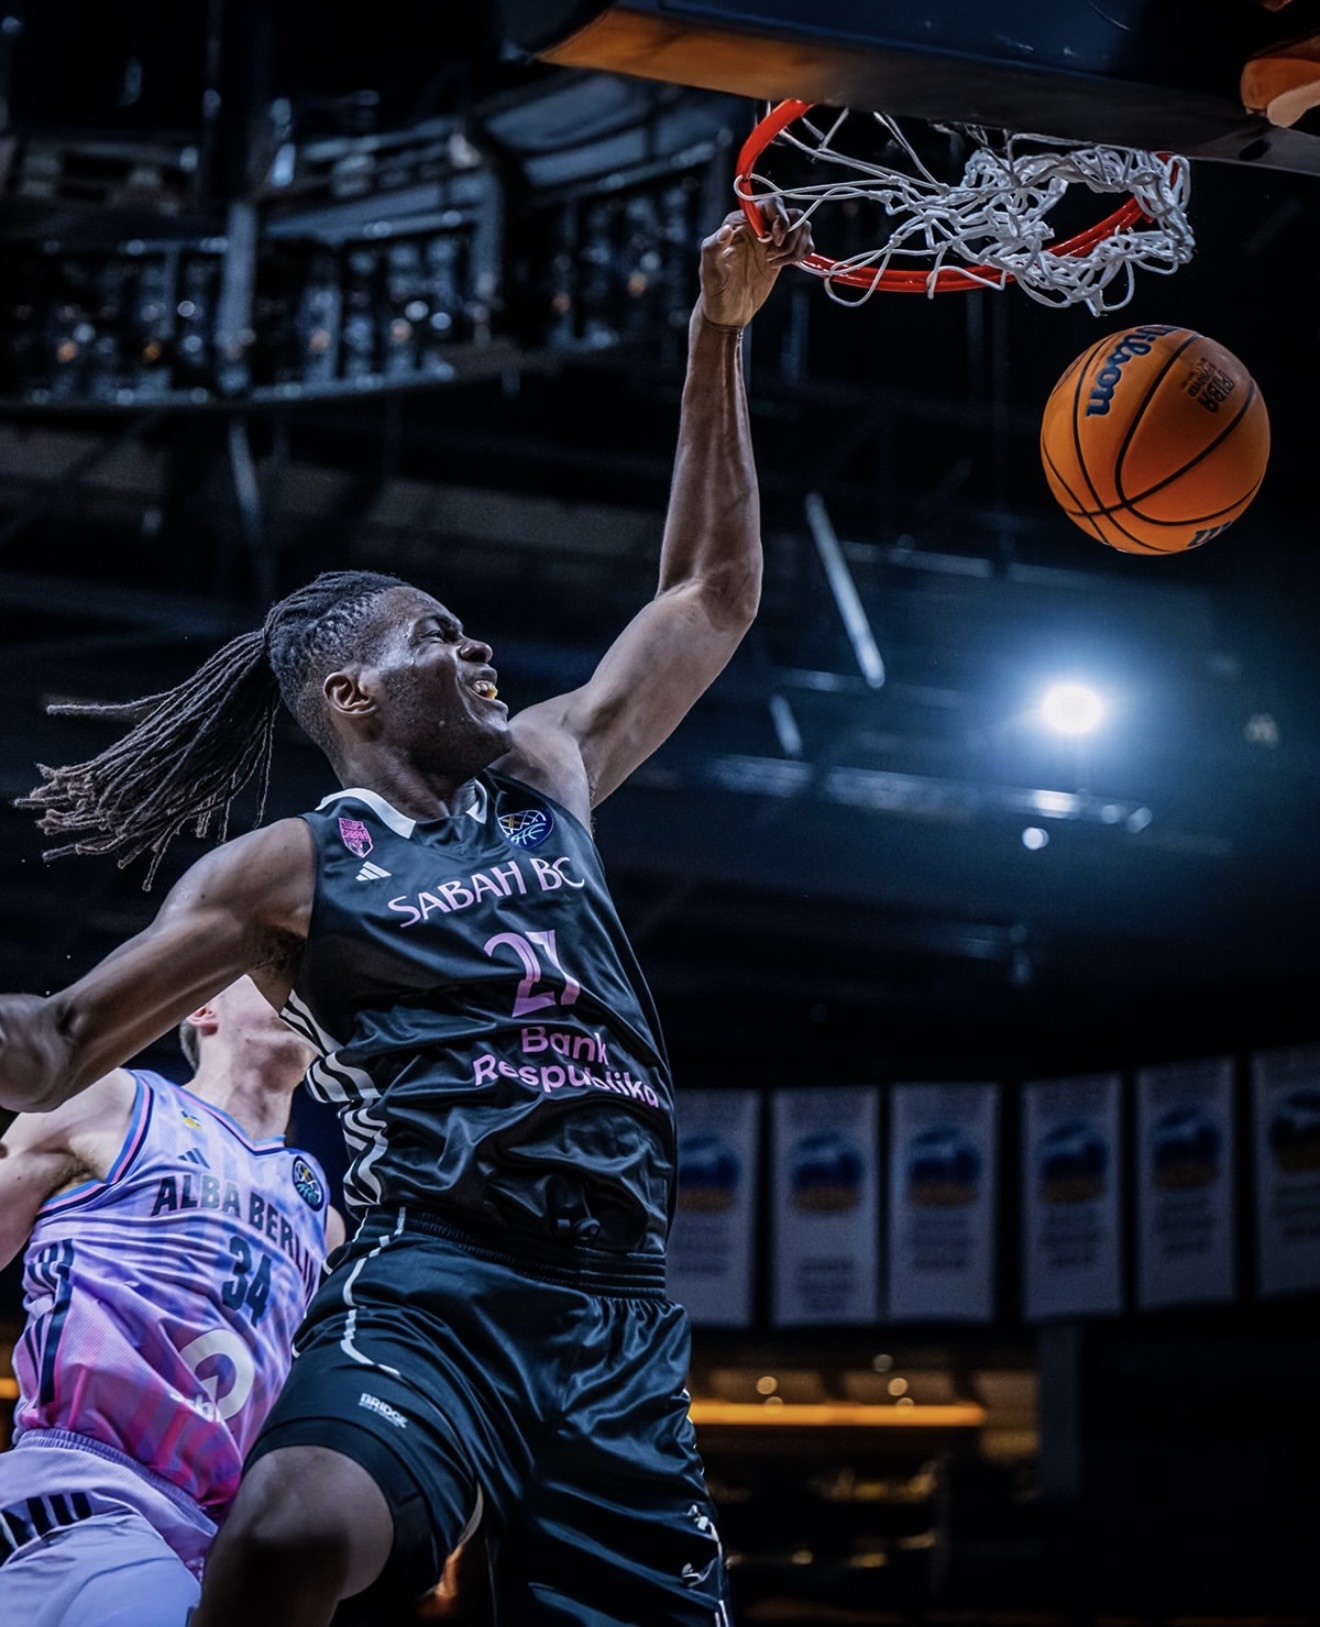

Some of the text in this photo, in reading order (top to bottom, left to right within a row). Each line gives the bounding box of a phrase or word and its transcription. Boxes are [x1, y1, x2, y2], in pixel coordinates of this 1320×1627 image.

[387, 857, 585, 928] SABAH BC
[483, 929, 580, 1018] 21
[521, 1026, 609, 1066] Bank
[473, 1054, 659, 1108] Respublika
[151, 1175, 241, 1217] ALBA
[222, 1235, 272, 1328] 34
